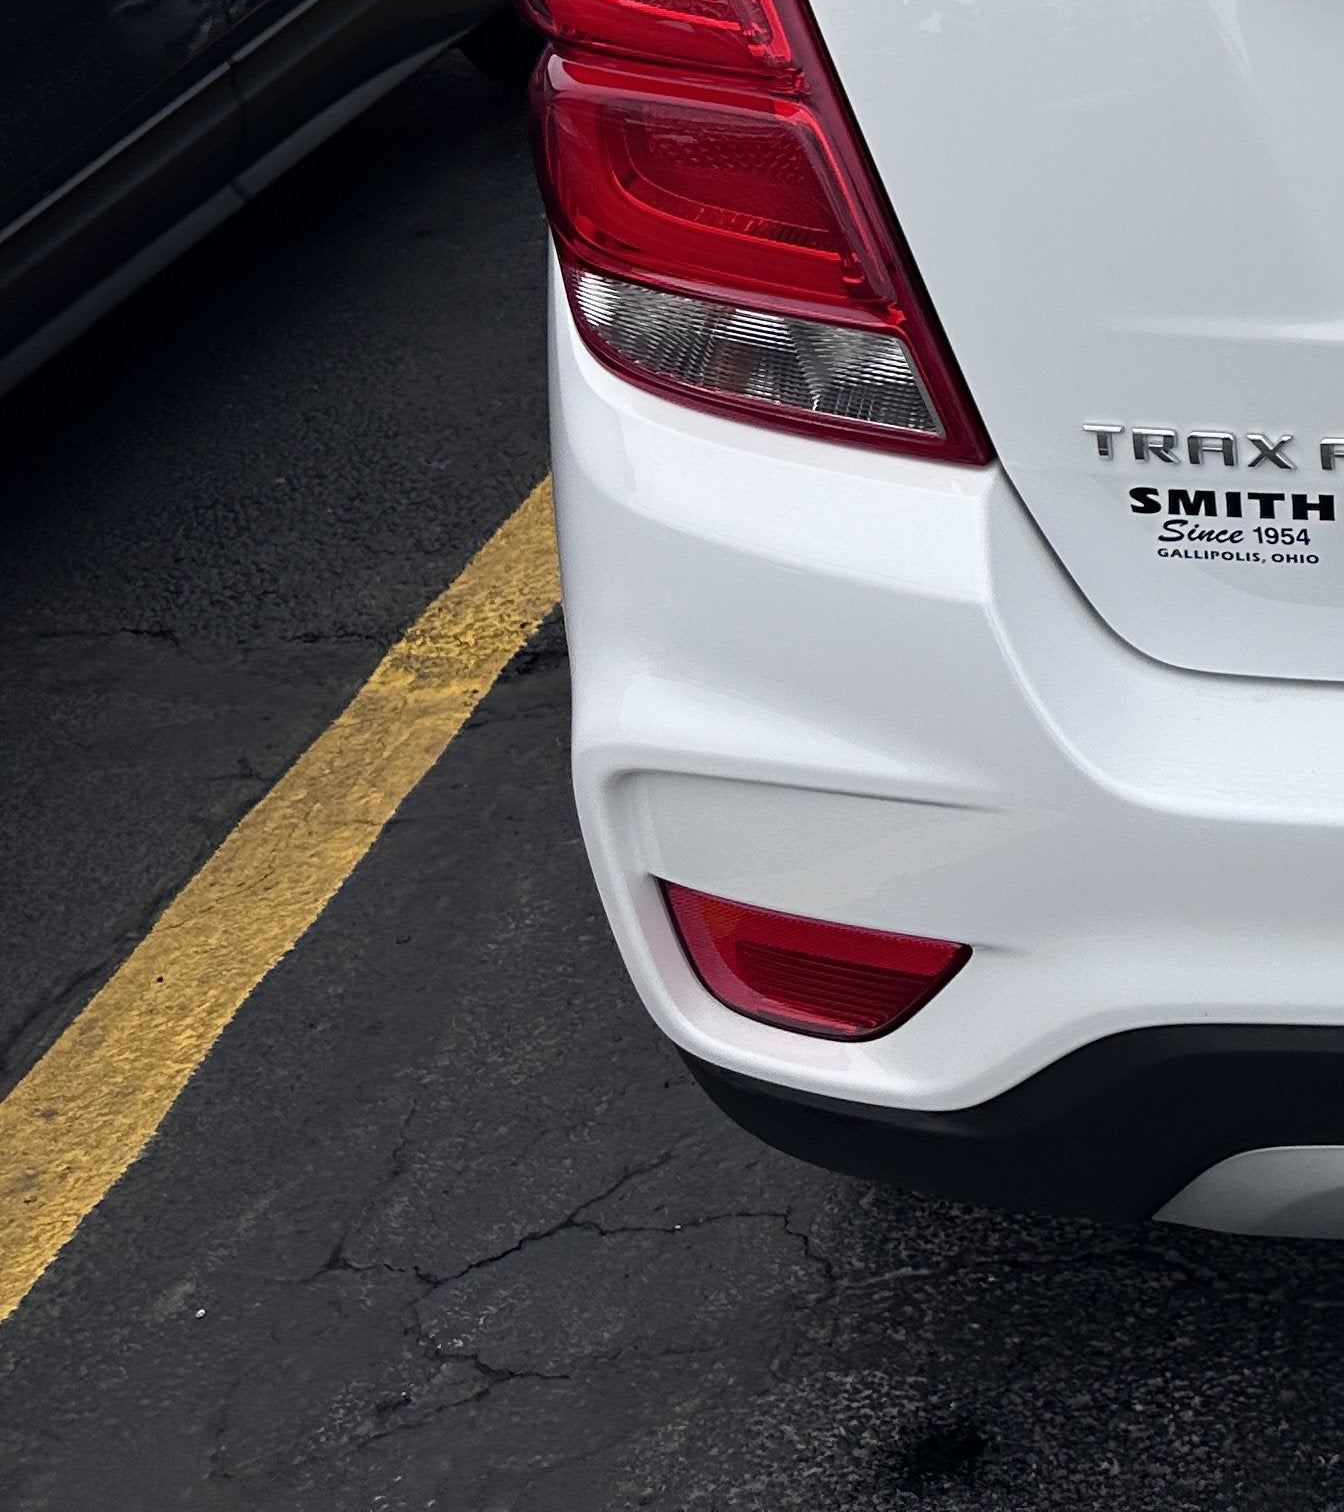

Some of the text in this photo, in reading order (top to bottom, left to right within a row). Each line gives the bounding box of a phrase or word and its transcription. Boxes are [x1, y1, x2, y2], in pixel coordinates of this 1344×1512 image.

[1082, 422, 1299, 470] TRAX
[1129, 486, 1336, 522] SMITH
[1157, 519, 1311, 546] Since 1954
[1157, 548, 1320, 565] GALLIPOLIS, OHIO
